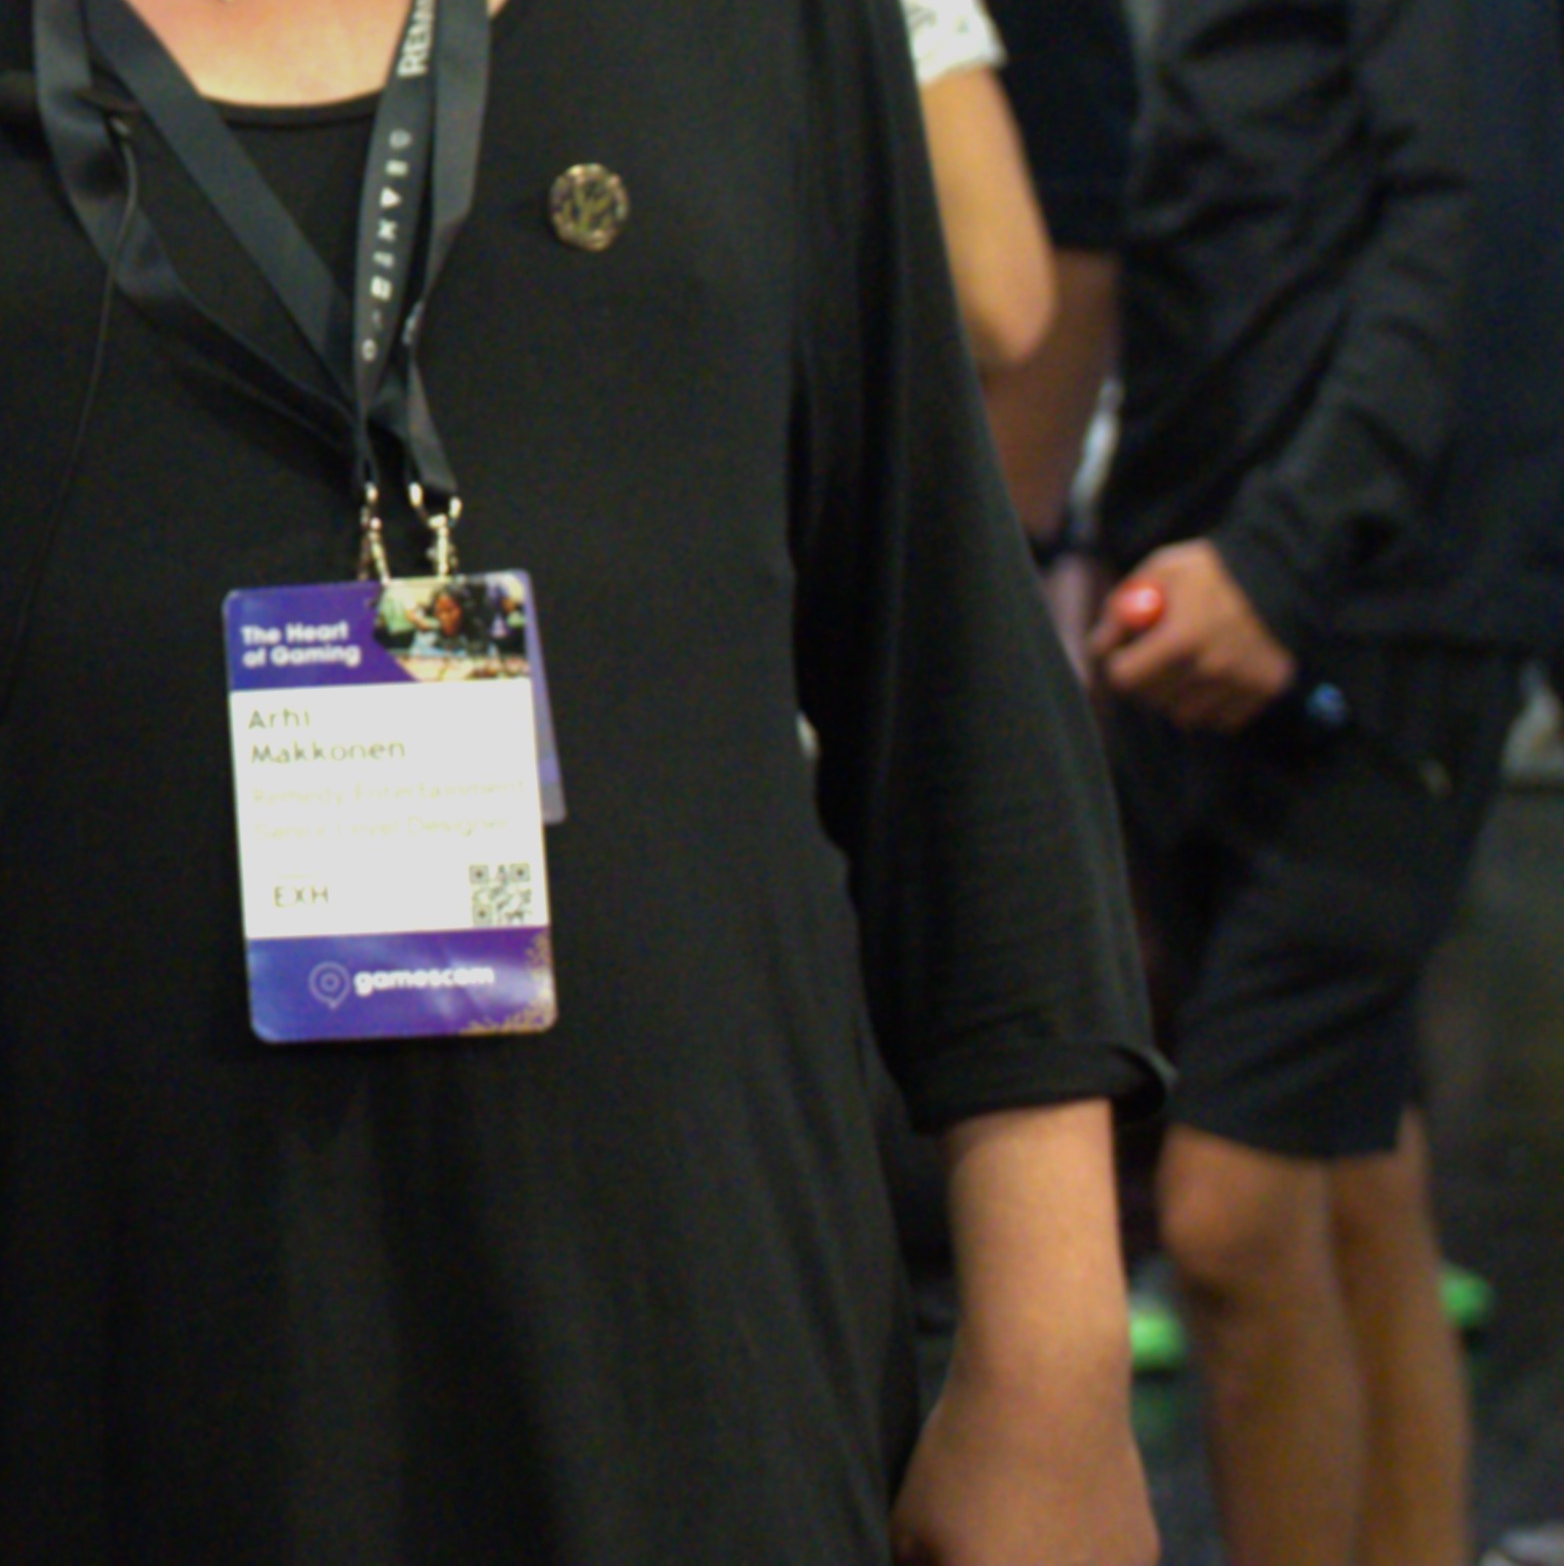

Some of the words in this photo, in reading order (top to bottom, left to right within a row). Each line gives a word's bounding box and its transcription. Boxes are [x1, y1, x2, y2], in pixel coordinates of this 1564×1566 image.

[240, 625, 282, 646] The
[285, 620, 349, 644] Heart
[242, 646, 267, 669] of
[270, 645, 361, 669] Gaming
[250, 739, 406, 764] Makkonen
[353, 966, 496, 998] gamescom
